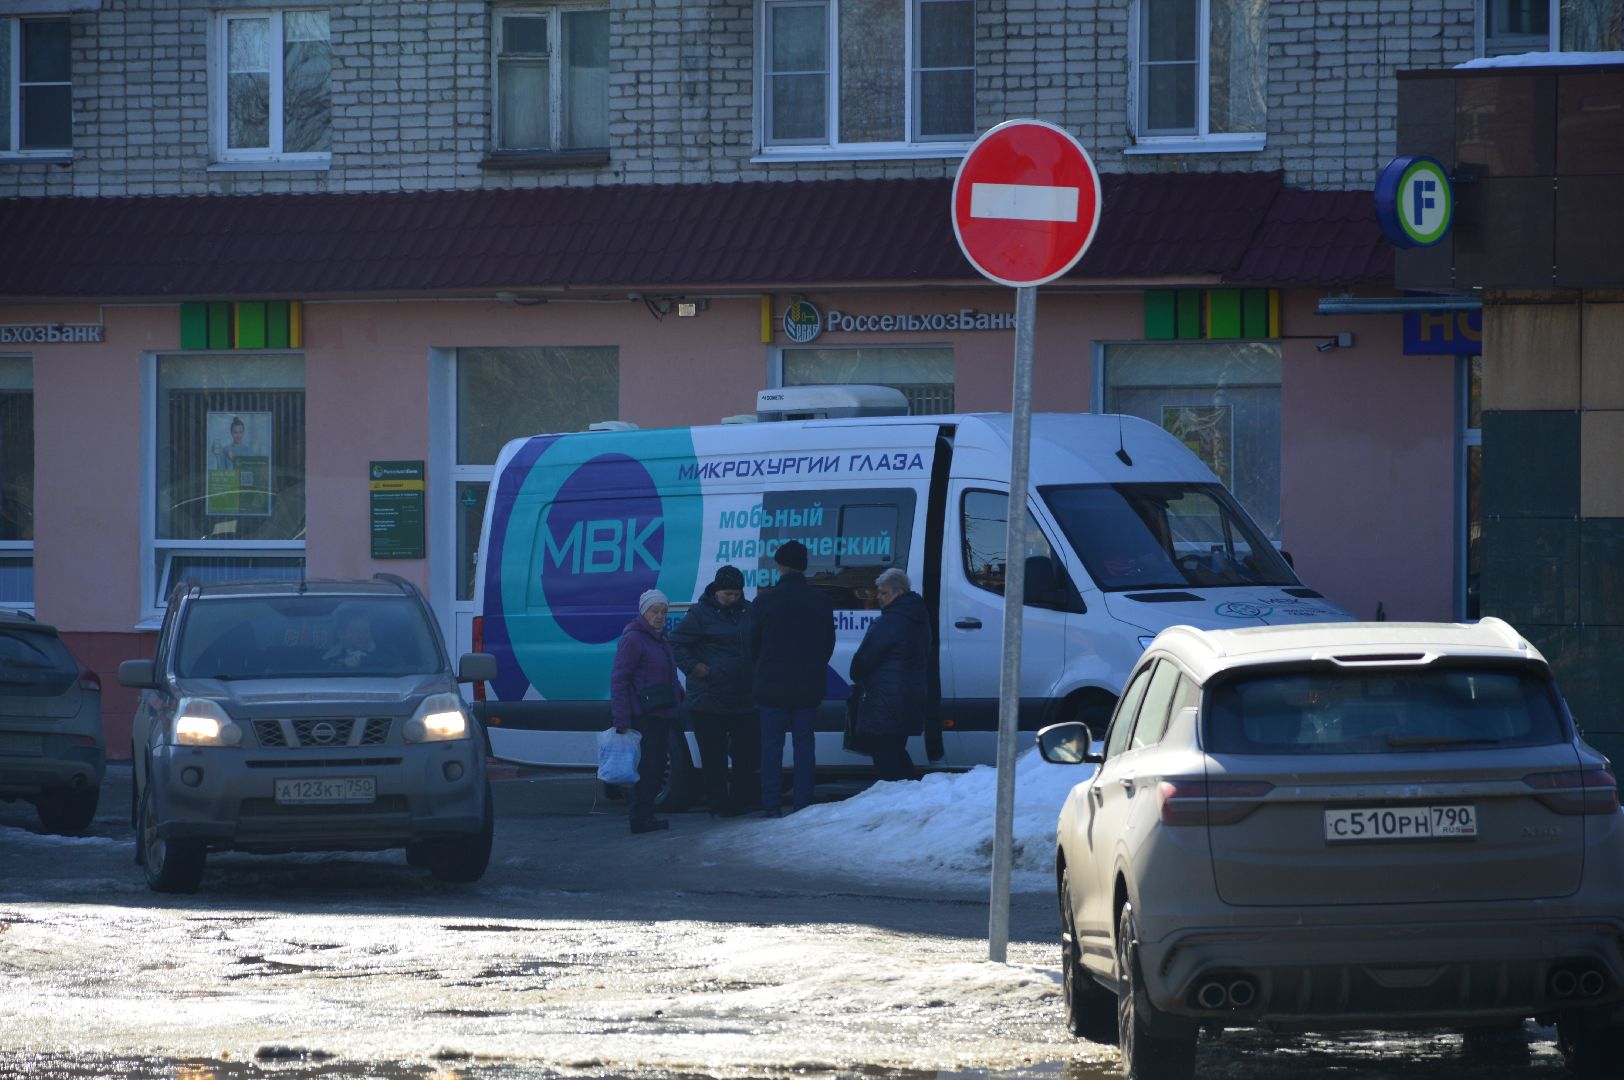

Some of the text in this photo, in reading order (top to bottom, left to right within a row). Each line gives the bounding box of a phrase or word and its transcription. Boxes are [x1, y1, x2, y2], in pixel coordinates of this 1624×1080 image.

[1414, 181, 1435, 225] F
[827, 309, 1017, 332] РоссельхозБанк
[0, 324, 101, 342] ьхозБанк
[849, 453, 924, 472] ГЛАЗА
[541, 516, 664, 576] МВК
[1333, 807, 1470, 836] С510РН 790
[1442, 825, 1462, 833] RUS
